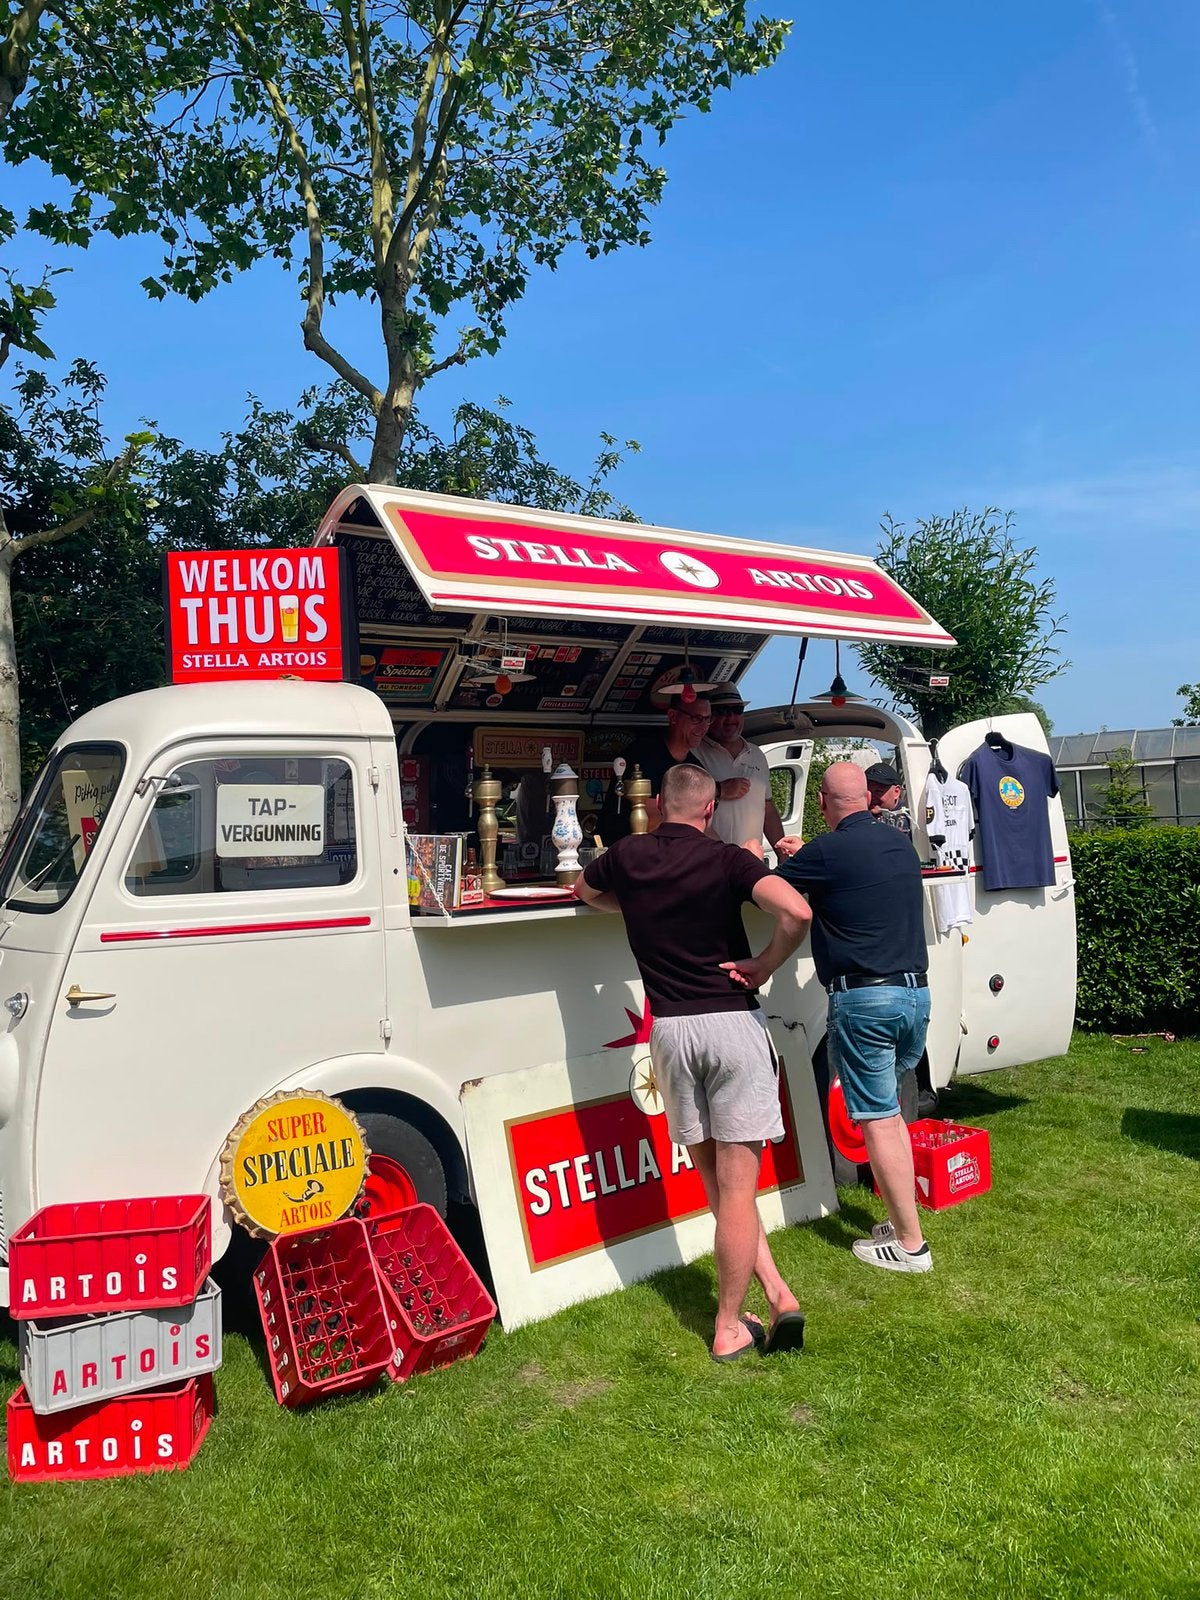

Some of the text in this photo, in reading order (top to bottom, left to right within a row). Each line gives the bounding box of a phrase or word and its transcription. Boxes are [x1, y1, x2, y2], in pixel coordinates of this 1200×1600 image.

[178, 556, 326, 593] WELKOM
[466, 536, 875, 600] STELLA ARTOIS
[182, 651, 327, 669] STELLA ARTOIS
[247, 797, 297, 816] TAP-
[220, 823, 322, 843] VERGUNNING
[267, 1111, 327, 1143] SUPER
[242, 1137, 356, 1188] SPECIALE
[525, 1138, 663, 1216] STELLA
[954, 1165, 975, 1179] STELLA
[279, 1200, 333, 1228] ARTOIS
